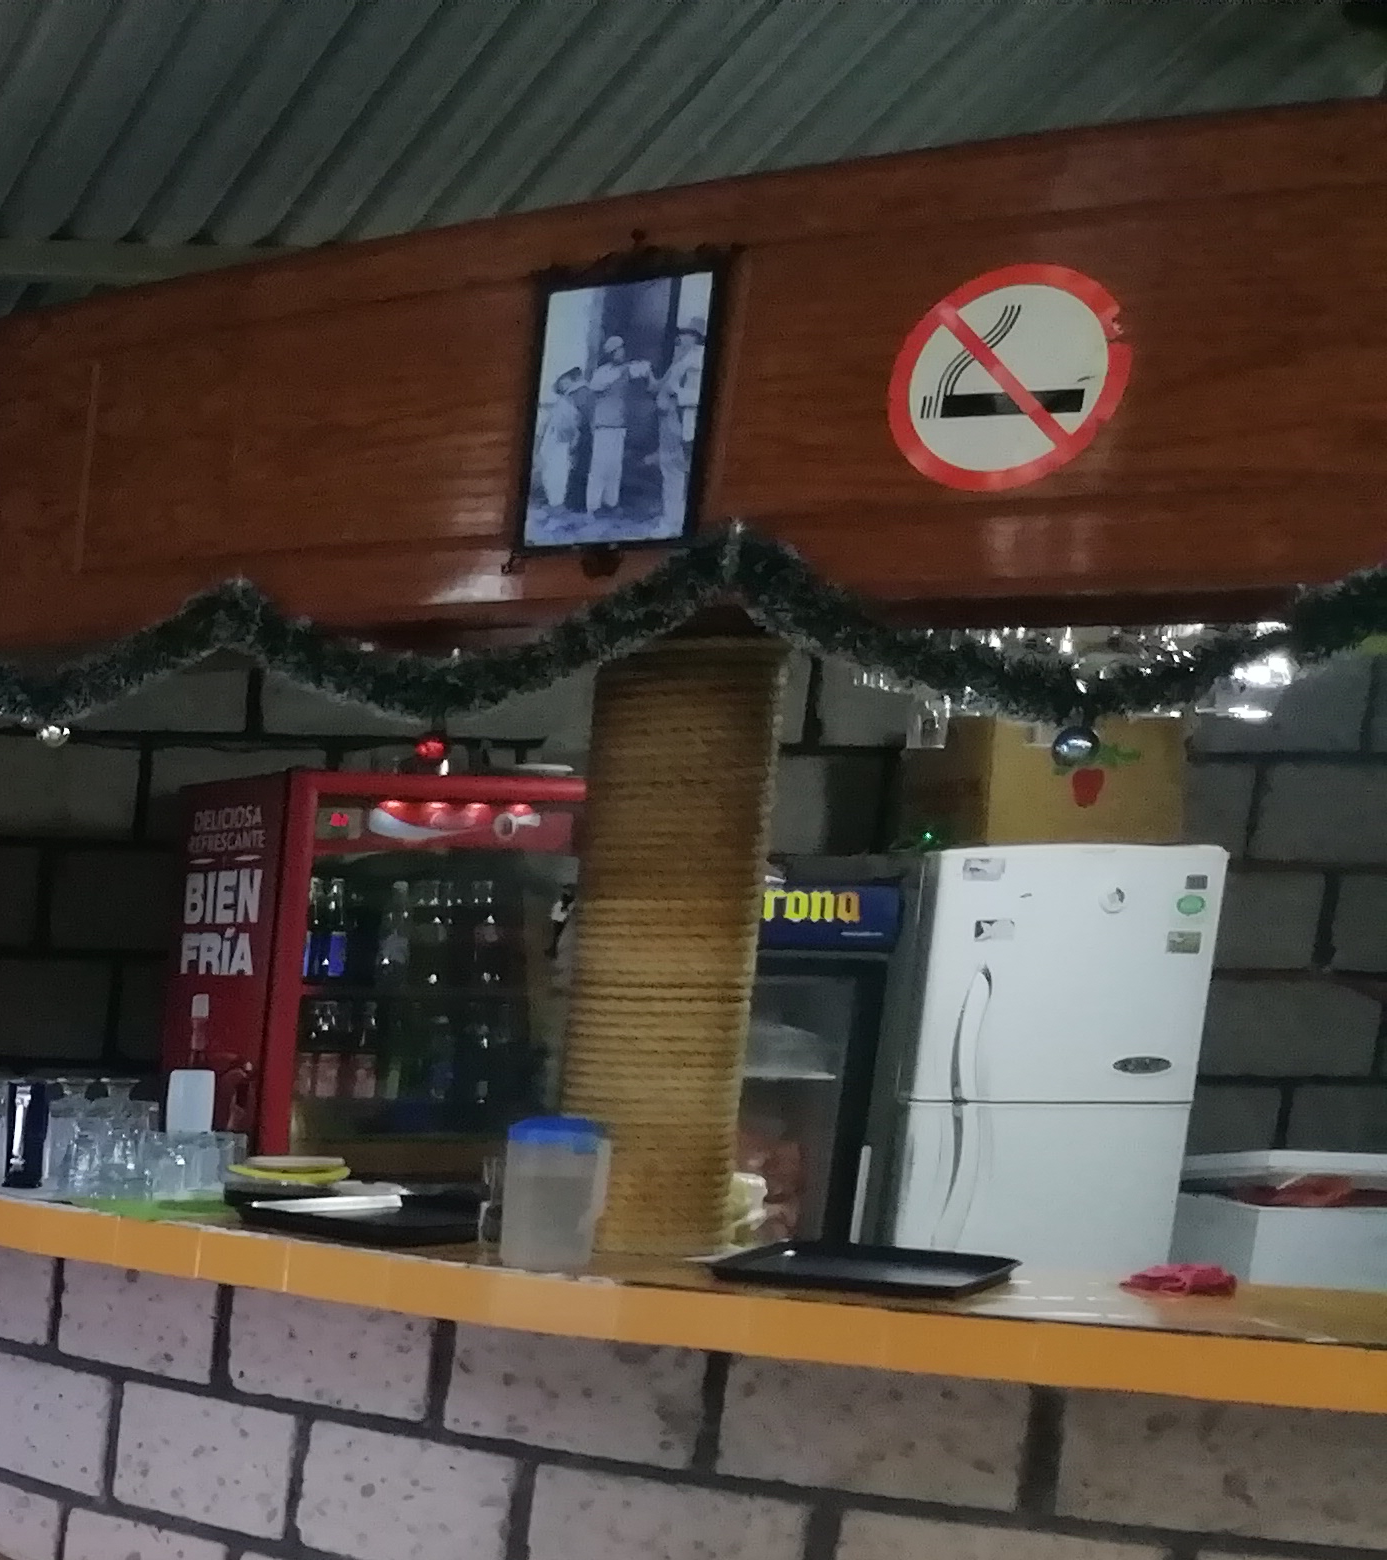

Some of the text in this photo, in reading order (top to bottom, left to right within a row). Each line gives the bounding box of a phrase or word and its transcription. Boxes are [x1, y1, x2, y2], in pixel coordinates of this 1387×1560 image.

[194, 805, 262, 831] DELICIOSA
[184, 869, 263, 924] BIEN
[763, 889, 861, 922] rona
[179, 926, 254, 977] FRÍA
